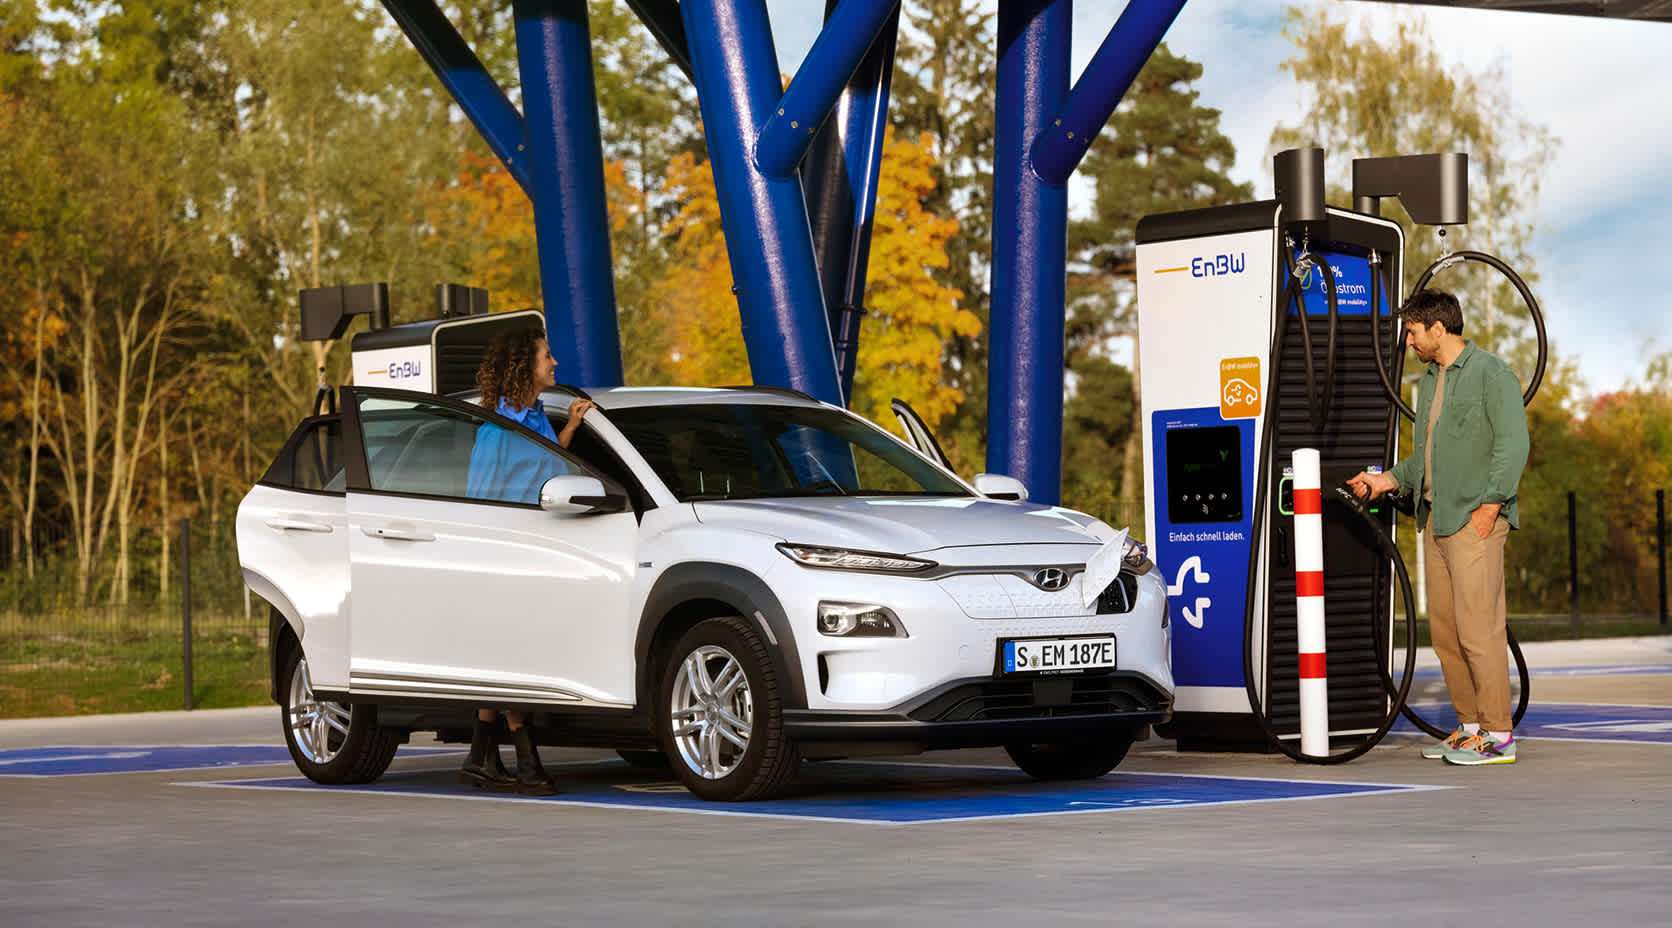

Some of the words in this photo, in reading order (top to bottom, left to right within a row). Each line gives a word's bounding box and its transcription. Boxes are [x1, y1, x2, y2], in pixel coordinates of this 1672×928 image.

[1192, 253, 1245, 277] EnBW
[389, 360, 421, 378] EnBW
[1169, 532, 1195, 542] Einfach
[1196, 530, 1221, 542] schnell
[1222, 530, 1245, 541] laden.
[1017, 646, 1028, 667] S
[1042, 645, 1065, 666] EM
[1070, 642, 1113, 665] 187E
